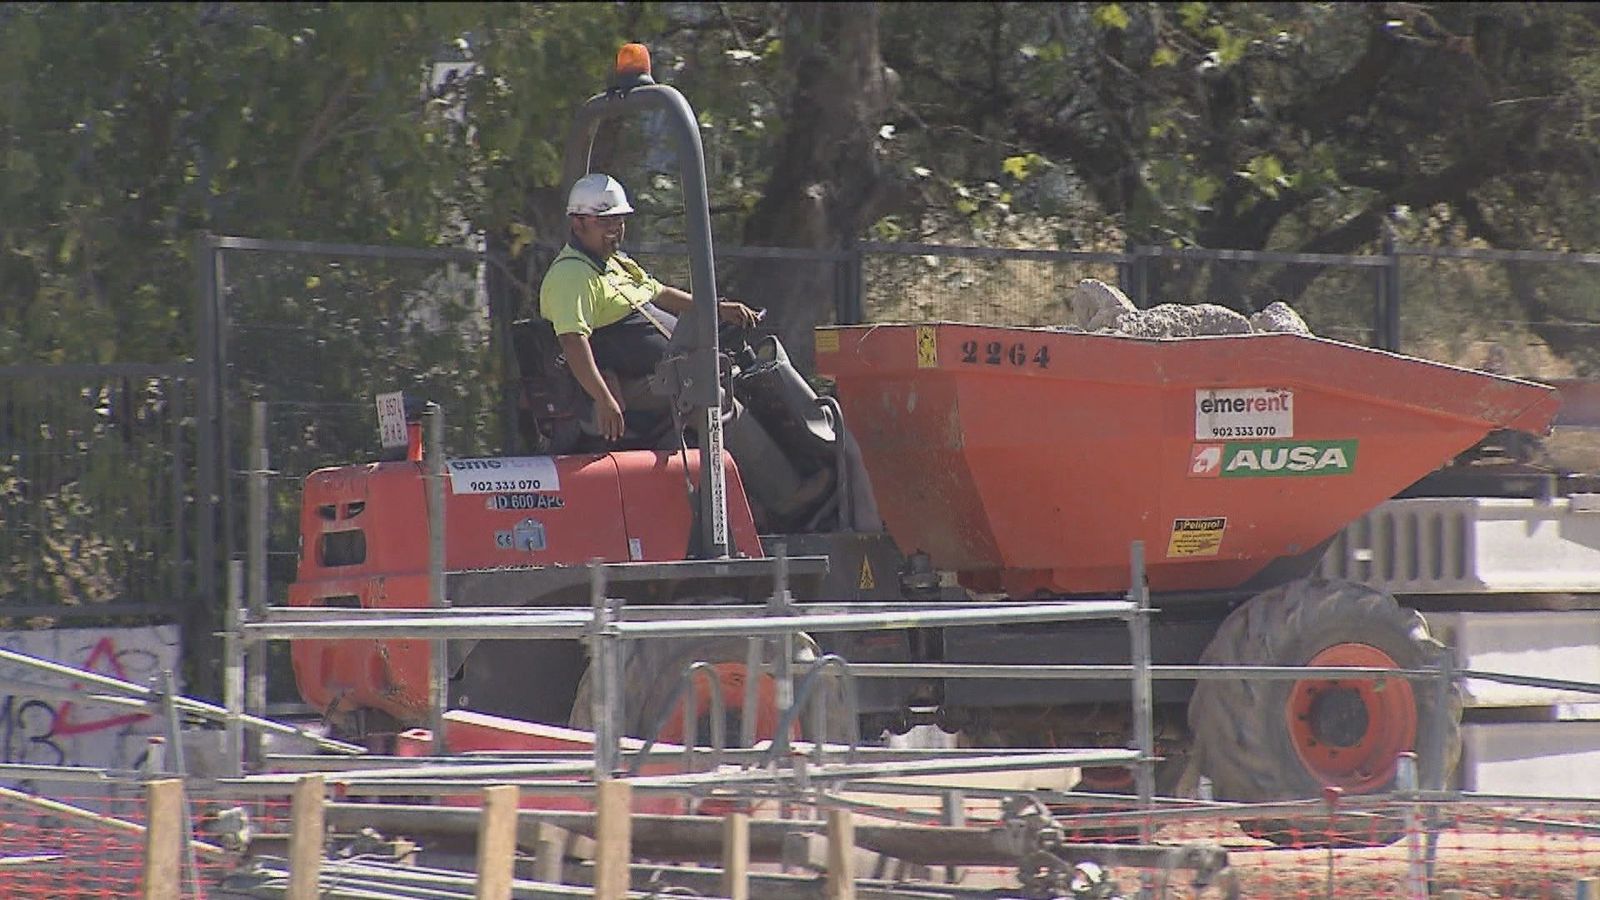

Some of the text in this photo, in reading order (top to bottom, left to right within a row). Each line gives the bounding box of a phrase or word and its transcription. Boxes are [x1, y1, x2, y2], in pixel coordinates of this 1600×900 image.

[961, 340, 1050, 369] 2264
[1200, 392, 1289, 414] emerent
[1212, 426, 1277, 437] 902 333 070
[1226, 446, 1348, 472] AUSA
[470, 479, 541, 491] 902 333 070
[511, 494, 534, 508] 600
